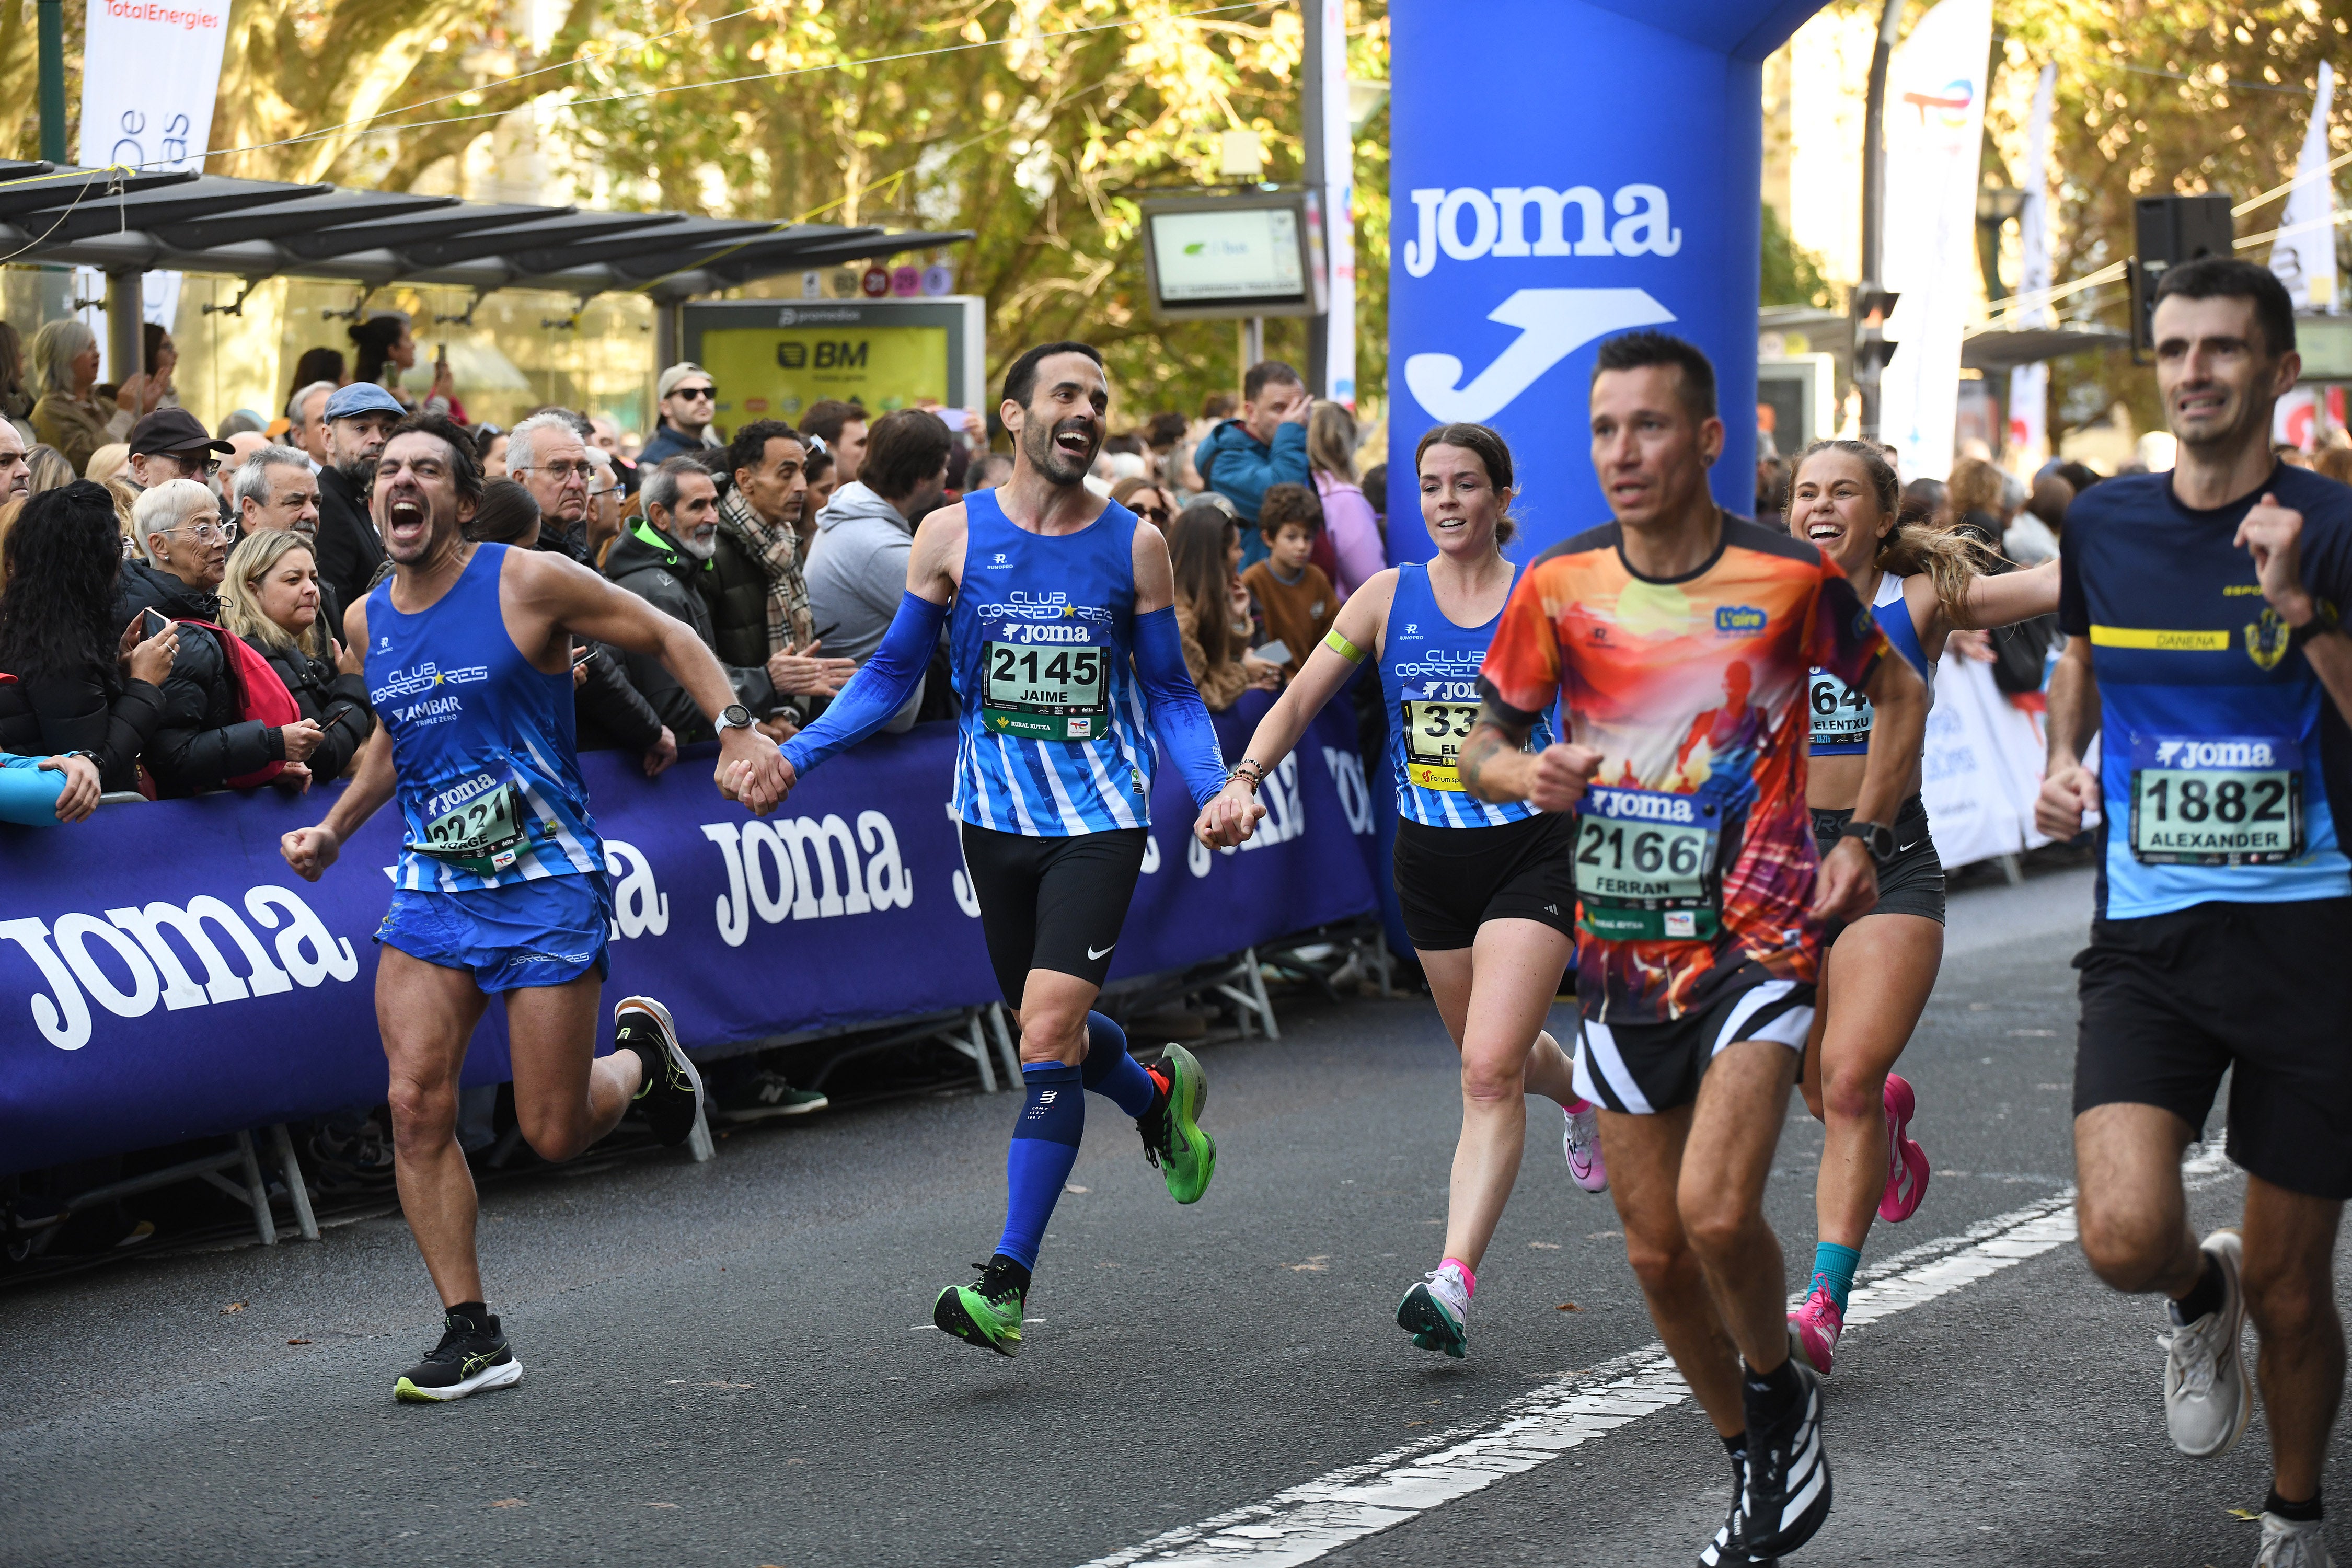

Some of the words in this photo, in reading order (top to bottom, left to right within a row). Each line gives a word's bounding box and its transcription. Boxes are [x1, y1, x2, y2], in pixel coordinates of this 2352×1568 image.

[106, 0, 218, 30] TotalEnergies
[1404, 183, 1682, 278] Joma
[815, 341, 869, 367] BM
[1010, 591, 1067, 605] CLUB
[1020, 624, 1090, 644] Joma
[2157, 633, 2215, 648] DANENA
[992, 648, 1098, 685] 2145
[1426, 650, 1486, 663] CLUB
[388, 662, 437, 684] CLUB
[1020, 690, 1068, 703] JAIME
[1811, 681, 1875, 716] 64
[405, 696, 463, 722] AMBAR
[415, 718, 438, 728] TRIPLE
[439, 713, 457, 722] ZERO
[1404, 705, 1410, 718] 1
[1814, 717, 1869, 730] ELENTXU
[1816, 735, 1831, 743] 10:21h
[1442, 757, 1456, 766] 10:00h
[2181, 741, 2276, 769] Joma
[438, 773, 497, 813] Joma
[2147, 778, 2285, 823] 1882
[433, 791, 506, 843] 2221
[1606, 791, 1695, 823] Joma
[501, 838, 514, 847] delta
[1578, 823, 1699, 875] 2166
[2150, 832, 2279, 848] ALEXANDER
[700, 810, 914, 948] Joma
[1596, 876, 1670, 895] FERRAN
[0, 884, 359, 1051] Joma
